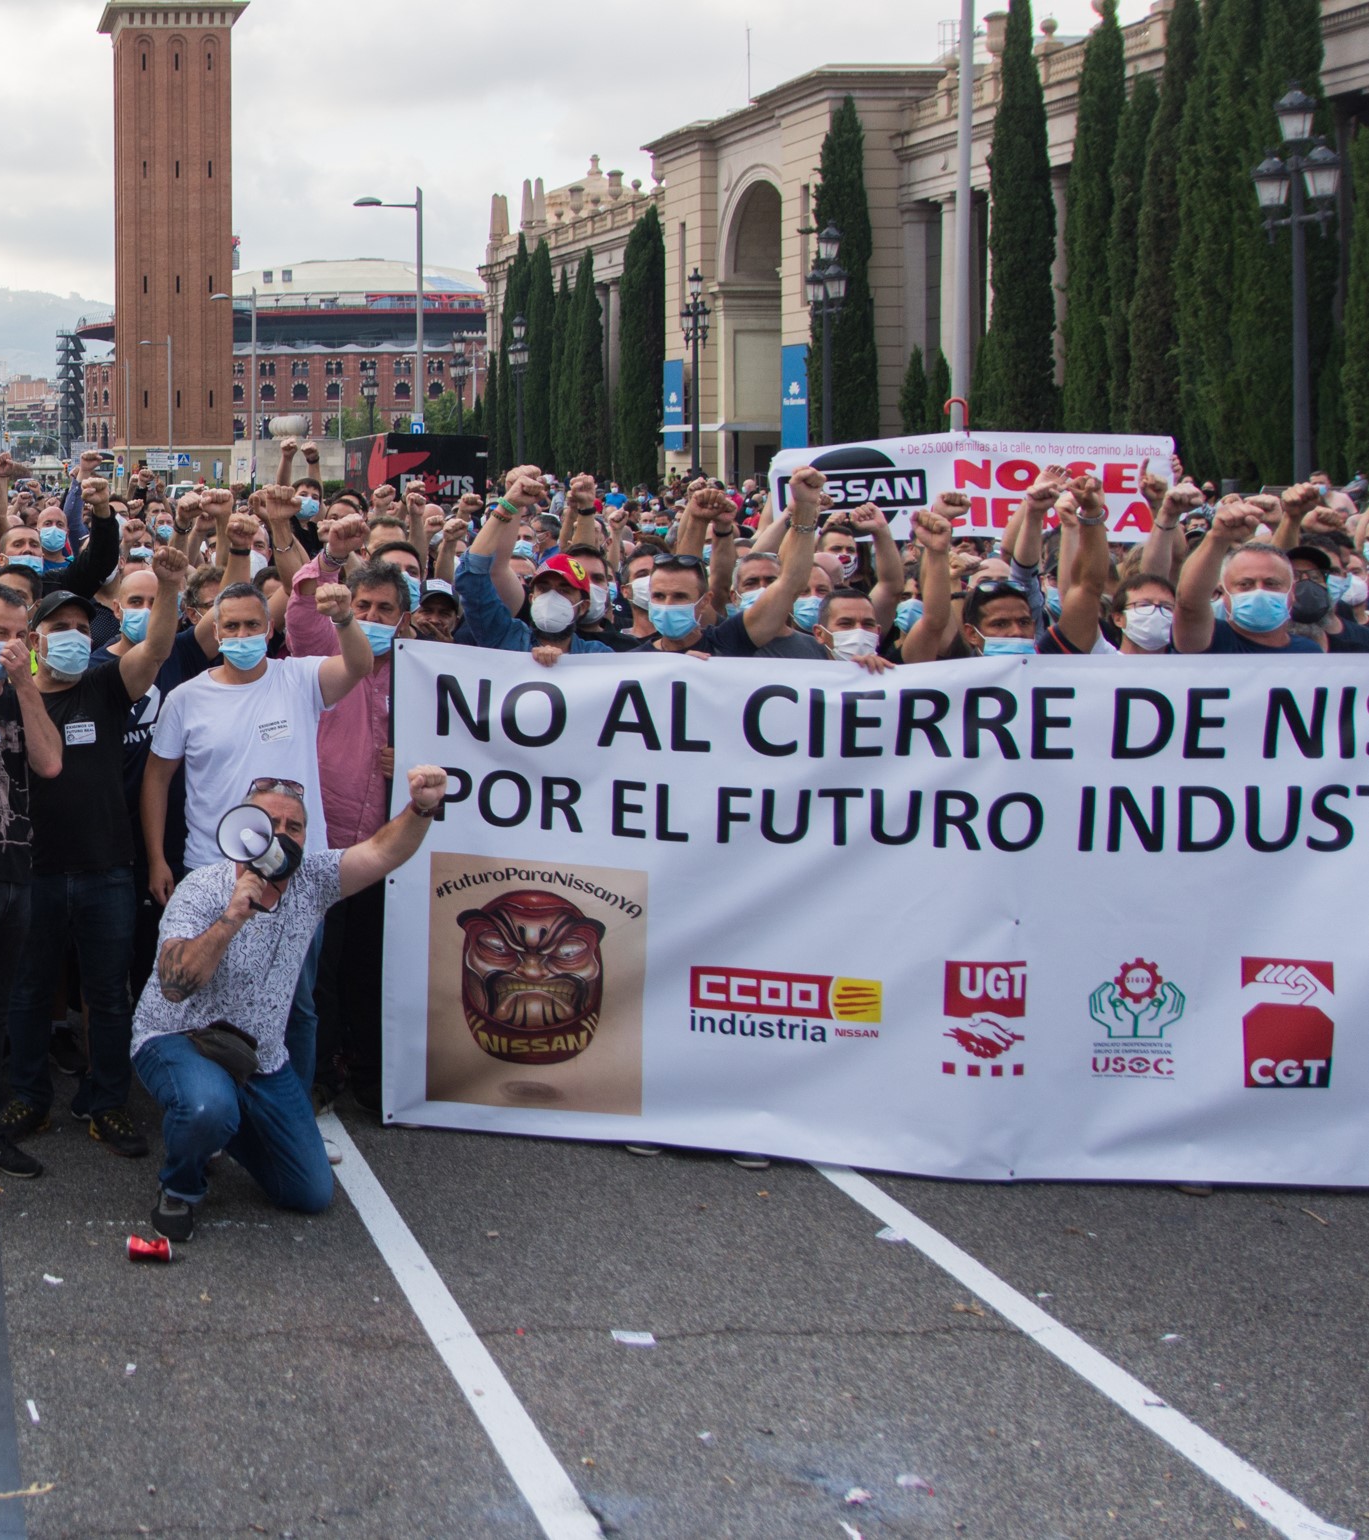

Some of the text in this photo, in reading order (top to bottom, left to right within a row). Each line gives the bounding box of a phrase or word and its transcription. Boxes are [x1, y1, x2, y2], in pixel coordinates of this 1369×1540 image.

[907, 444, 919, 454] De
[922, 442, 952, 453] 25.000
[955, 440, 989, 452] familias
[992, 444, 998, 452] a
[1000, 441, 1008, 452] la
[1035, 445, 1046, 454] no
[1048, 443, 1064, 456] hay
[1066, 445, 1084, 455] otro
[1087, 444, 1121, 455] camino
[784, 476, 921, 505] SSAN
[954, 459, 1040, 491] NO
[436, 673, 1369, 760] NO AL CIERRE DE NI
[433, 767, 1369, 853] POR EL FUTURO INDUS
[699, 974, 819, 1010] CCOO
[959, 966, 1028, 1000] UGT
[690, 1009, 880, 1042] indústria NISSAN
[478, 1031, 588, 1053] NISSAN
[1092, 1056, 1175, 1075] USOC
[1250, 1058, 1326, 1084] CGT
